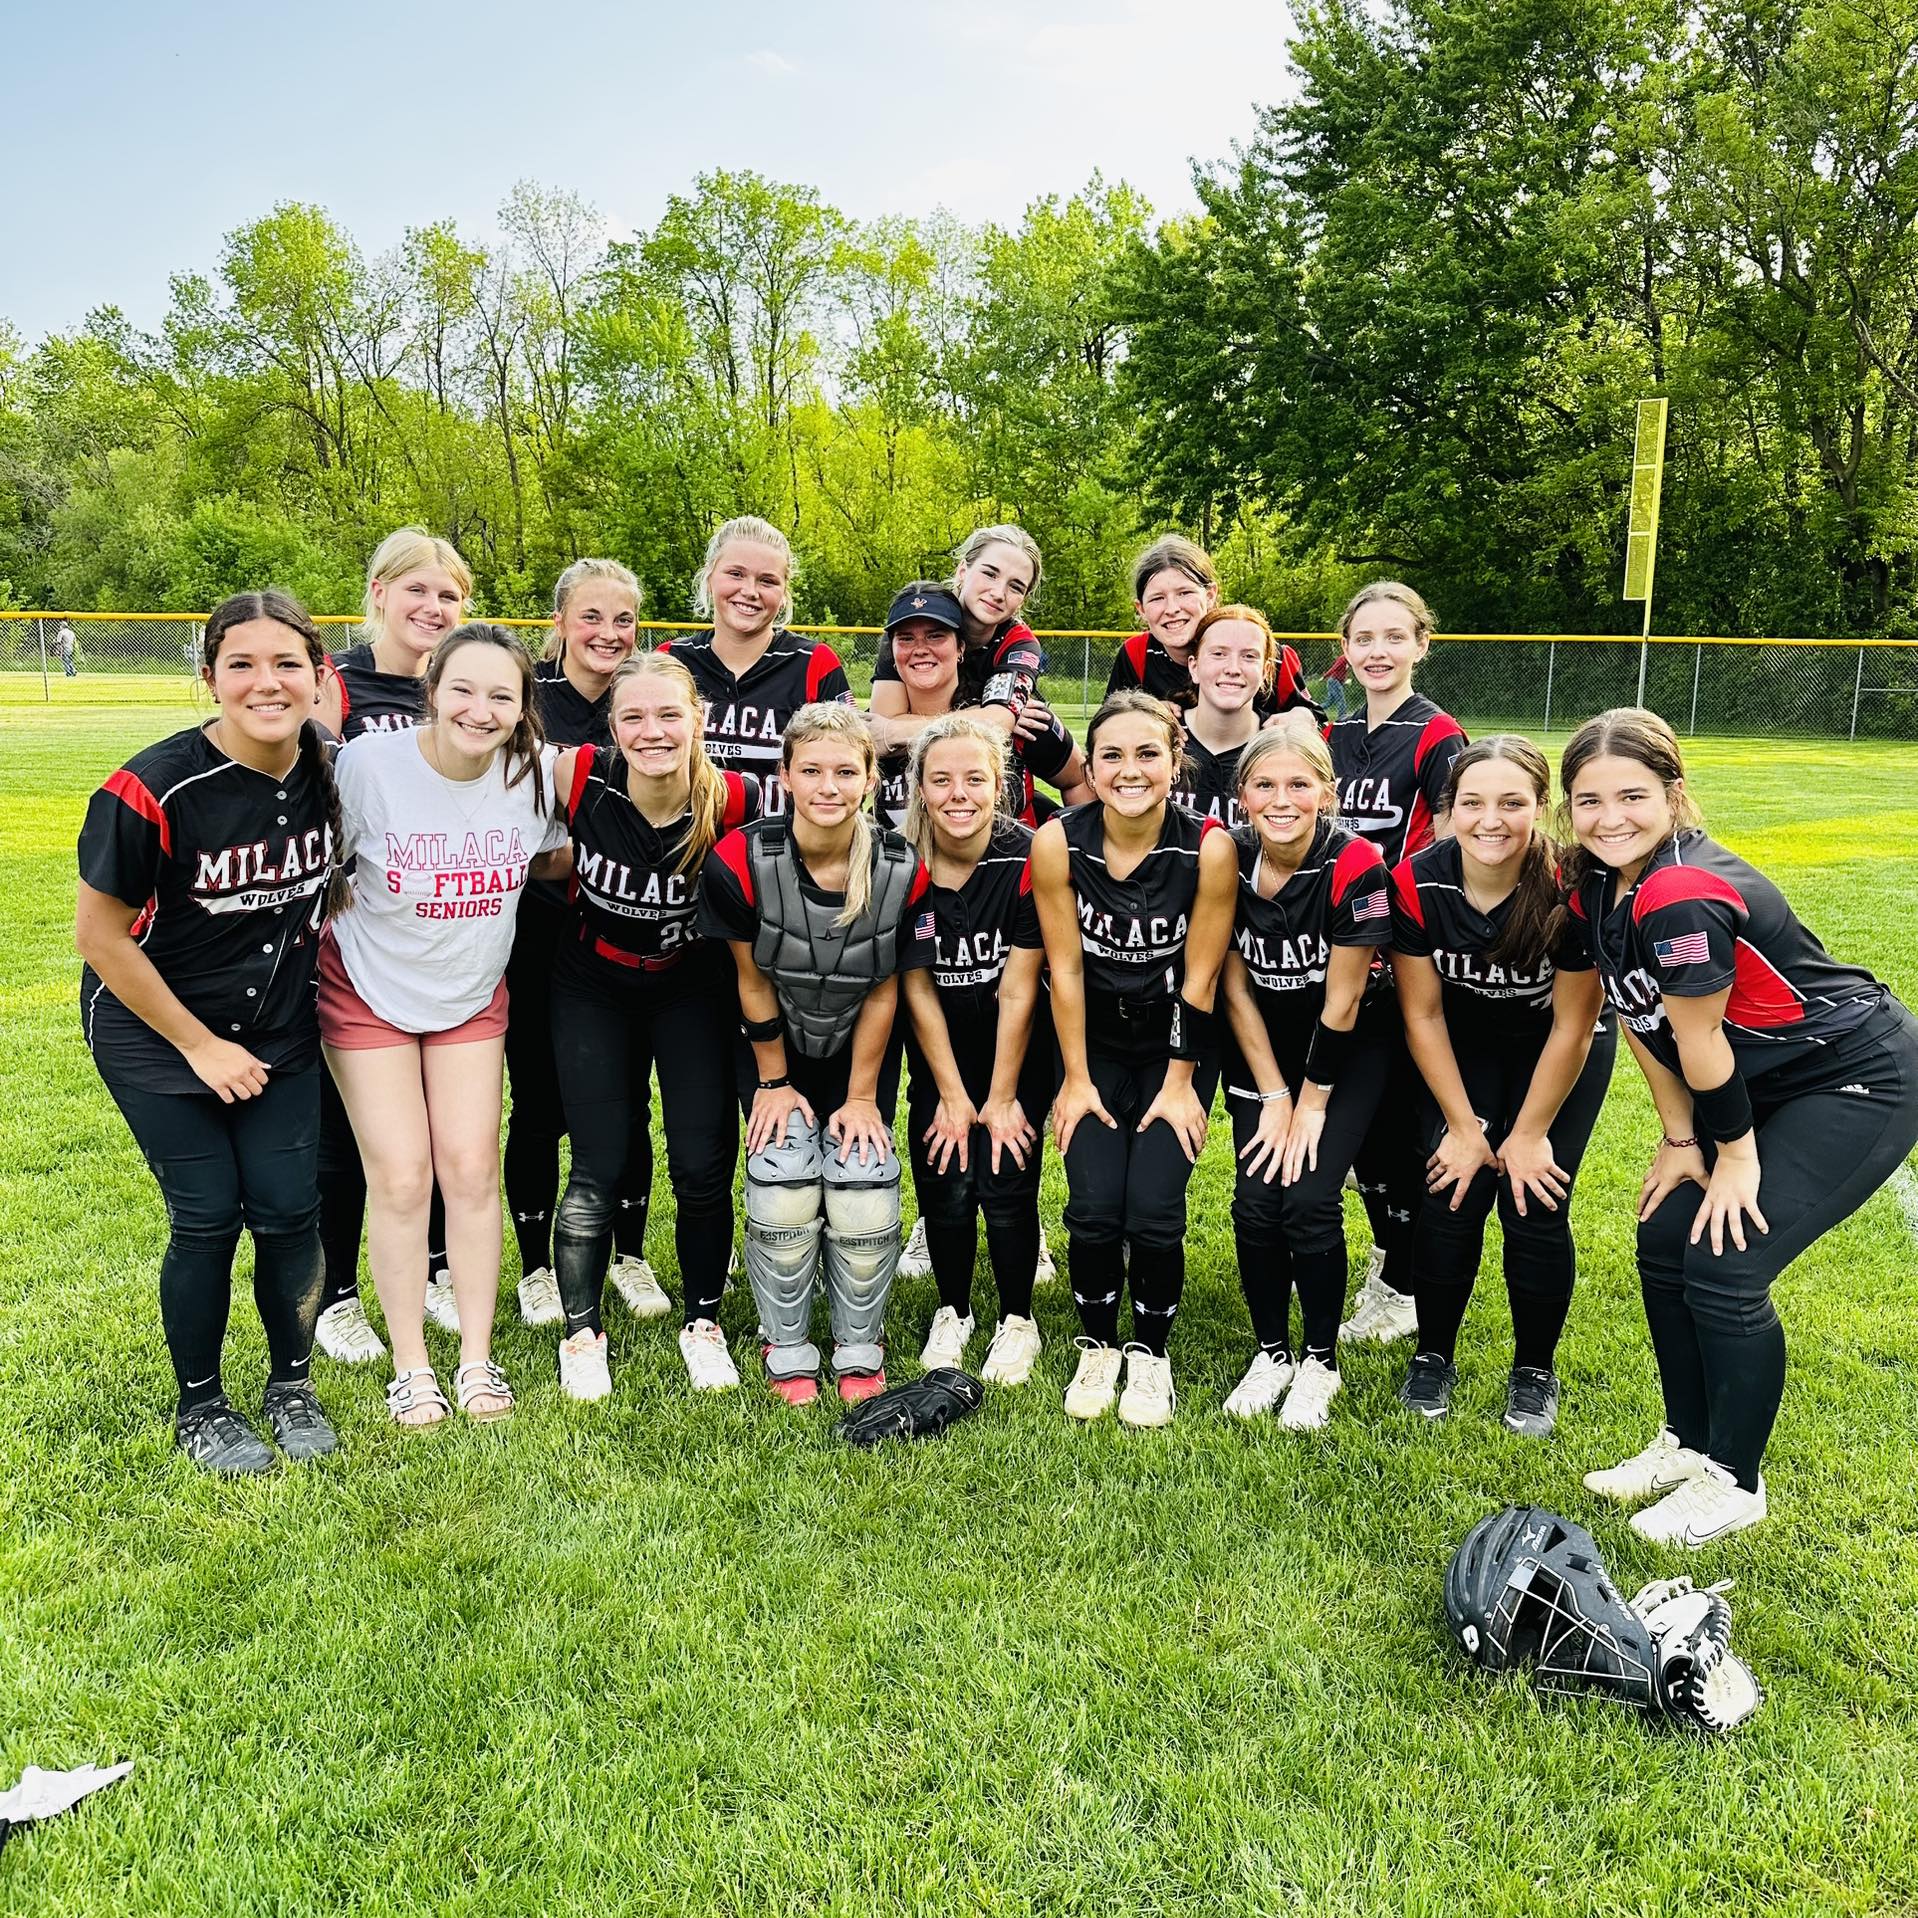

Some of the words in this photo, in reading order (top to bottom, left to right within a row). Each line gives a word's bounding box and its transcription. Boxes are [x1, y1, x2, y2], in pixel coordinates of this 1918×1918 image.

[385, 826, 529, 871] MILACA
[239, 882, 306, 907] WOLVES
[415, 897, 503, 920] SENIORS
